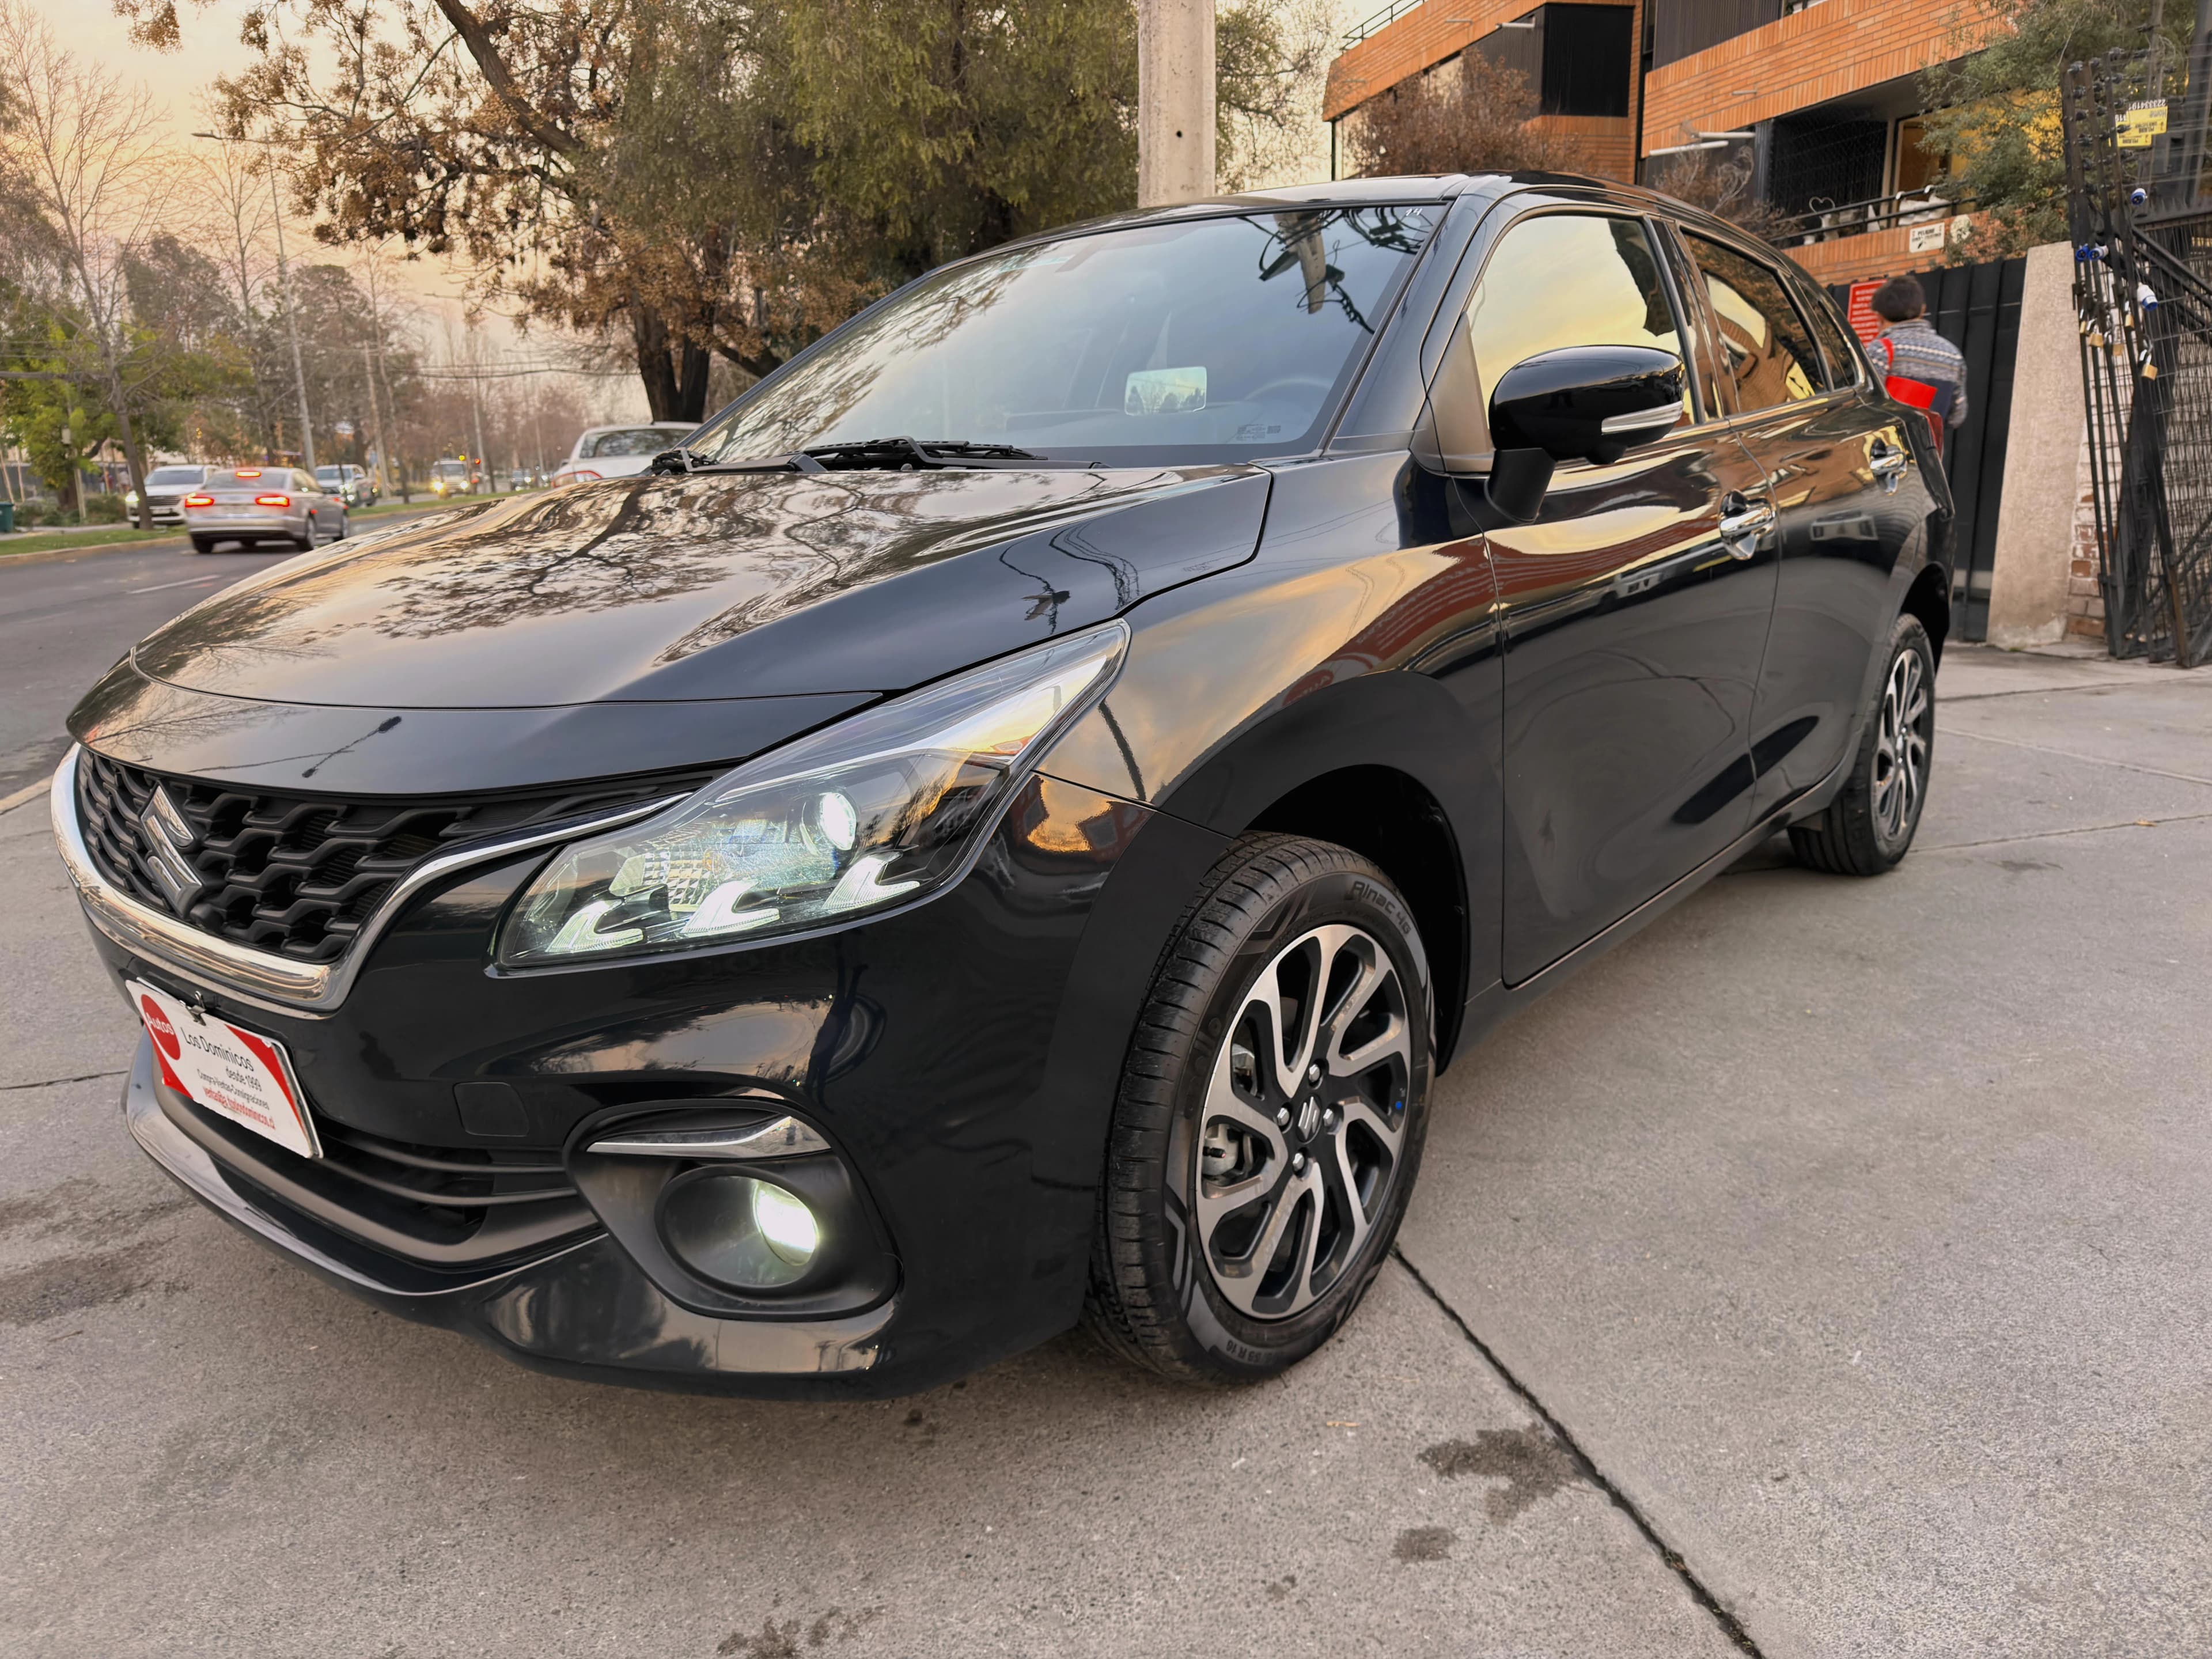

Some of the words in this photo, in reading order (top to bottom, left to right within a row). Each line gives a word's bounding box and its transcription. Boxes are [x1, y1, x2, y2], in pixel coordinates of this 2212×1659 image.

[145, 1012, 175, 1035] Autos
[180, 1027, 201, 1049] Los
[199, 1035, 254, 1071] Dominicos
